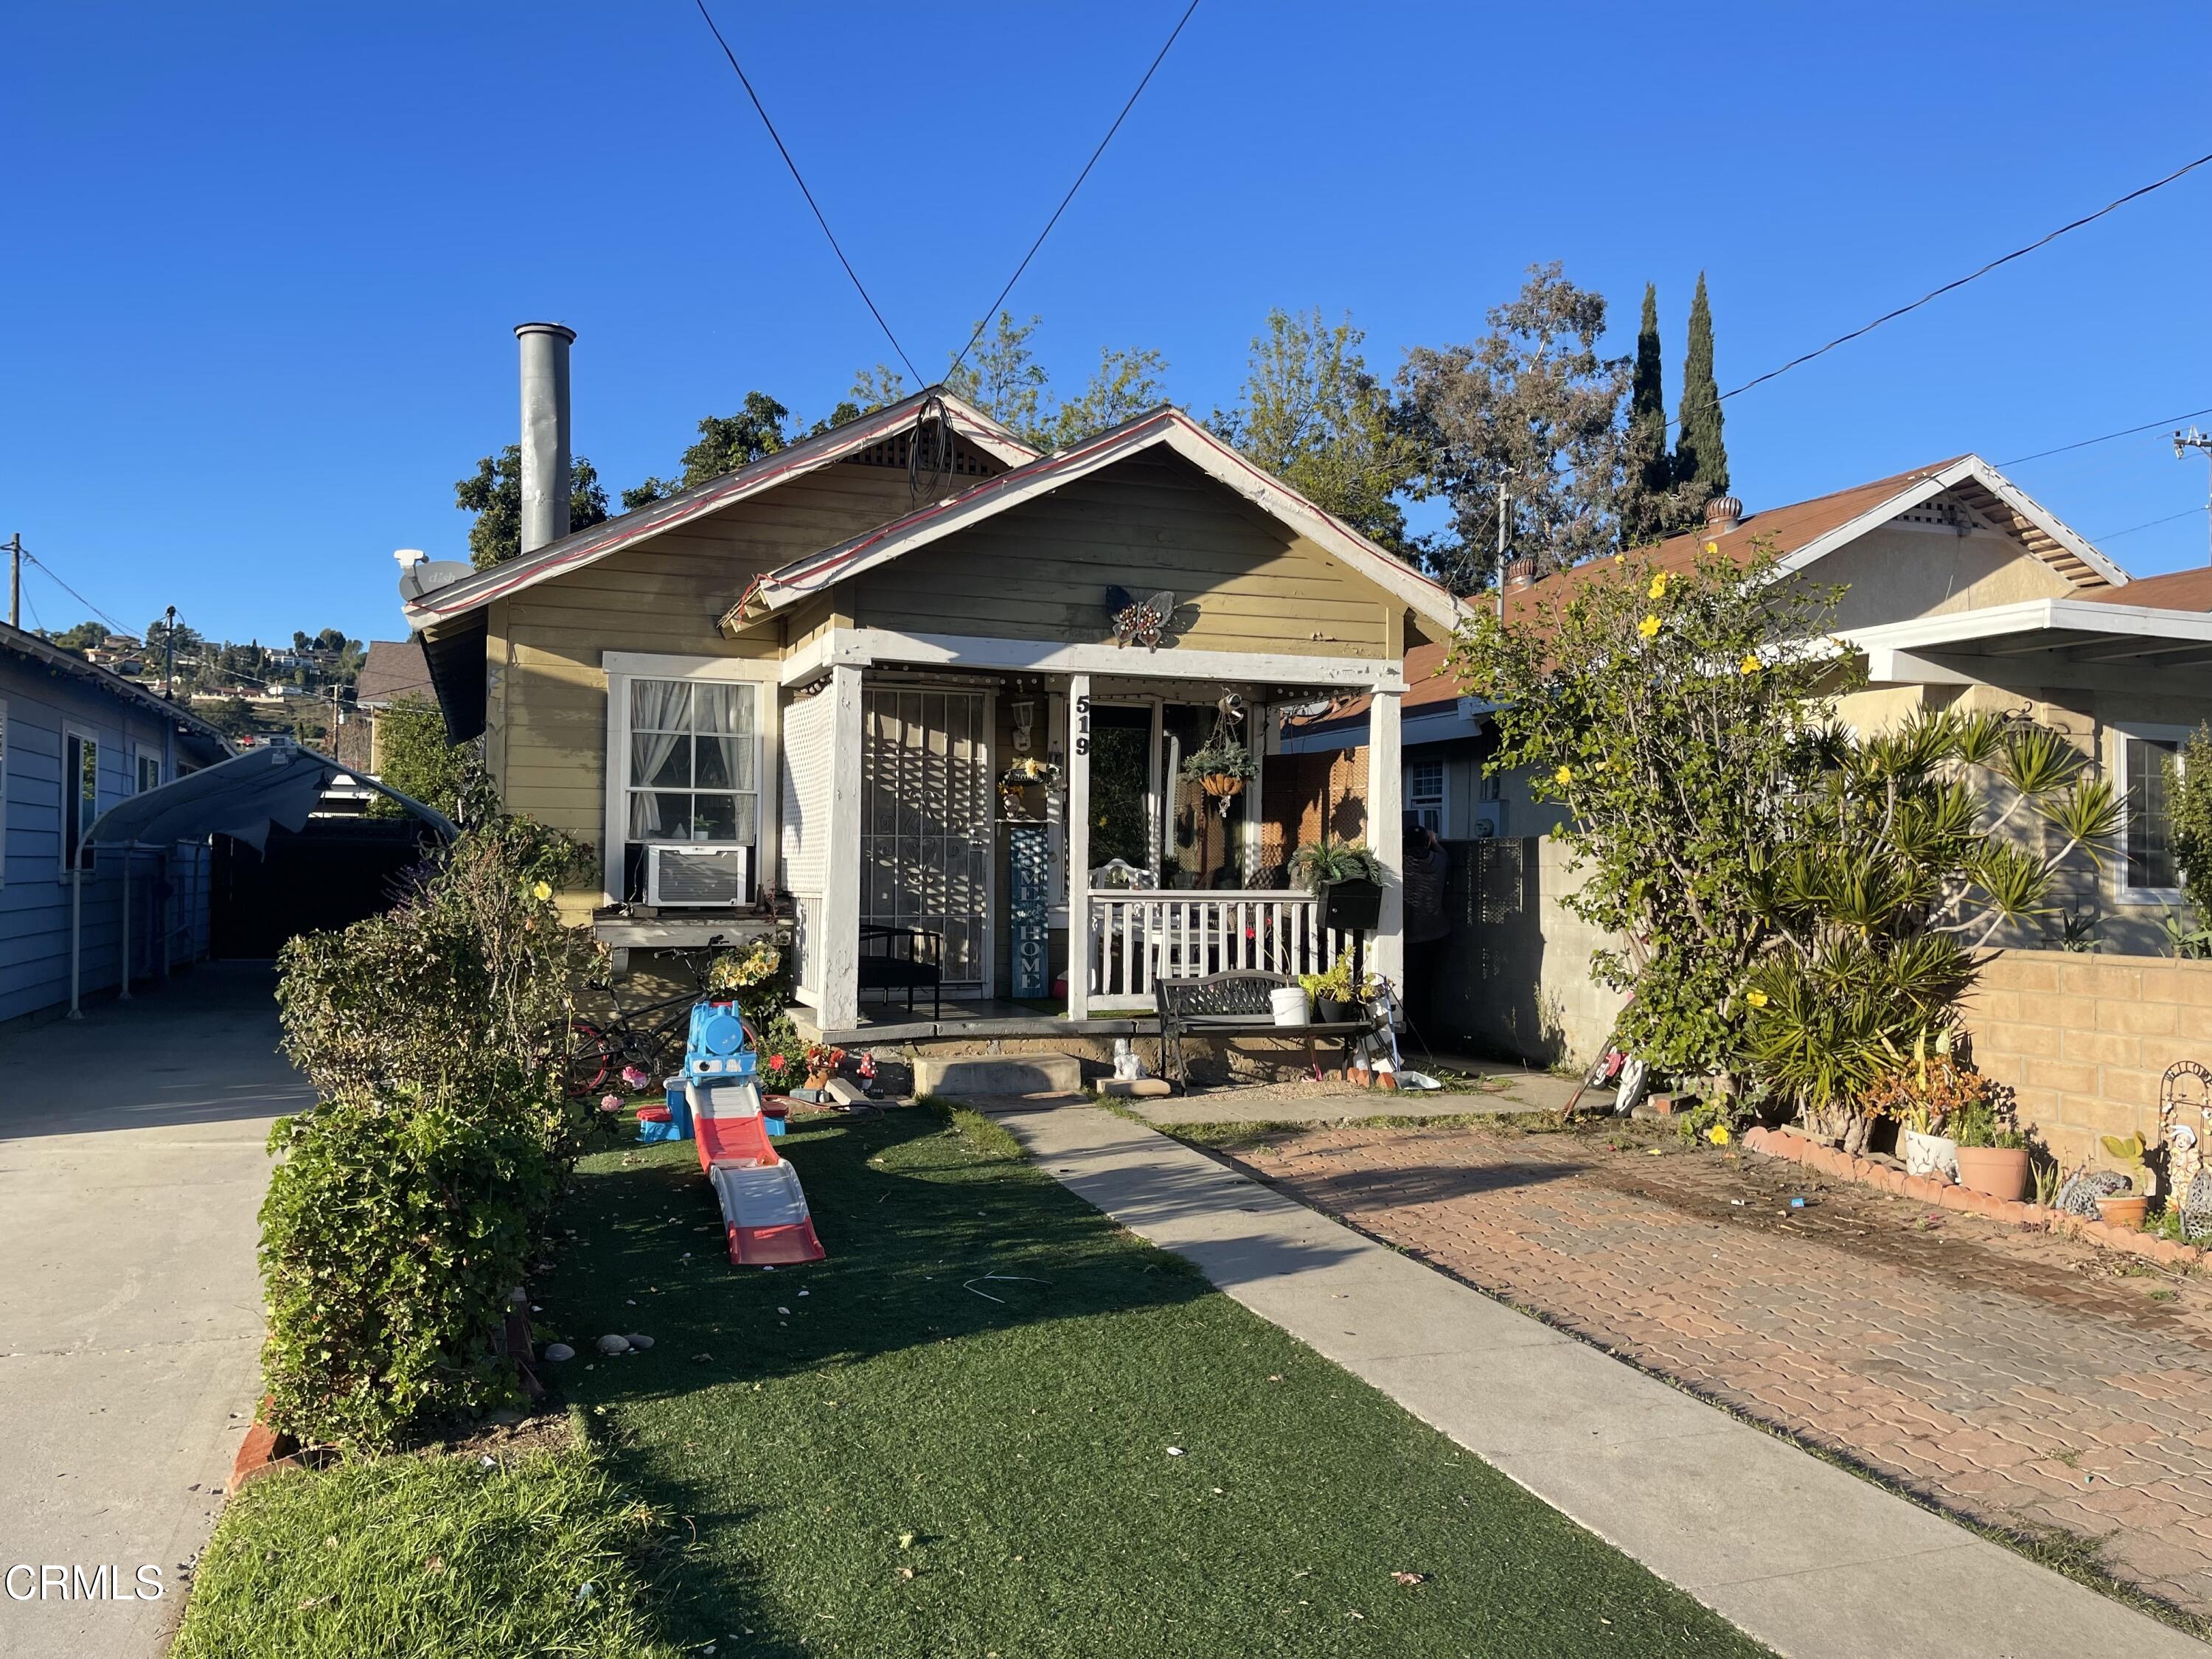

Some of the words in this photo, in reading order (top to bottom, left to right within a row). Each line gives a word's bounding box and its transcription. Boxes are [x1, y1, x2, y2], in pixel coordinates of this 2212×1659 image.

[428, 572, 456, 583] dish
[1076, 695, 1089, 756] 519
[1020, 925, 1041, 989] HOME
